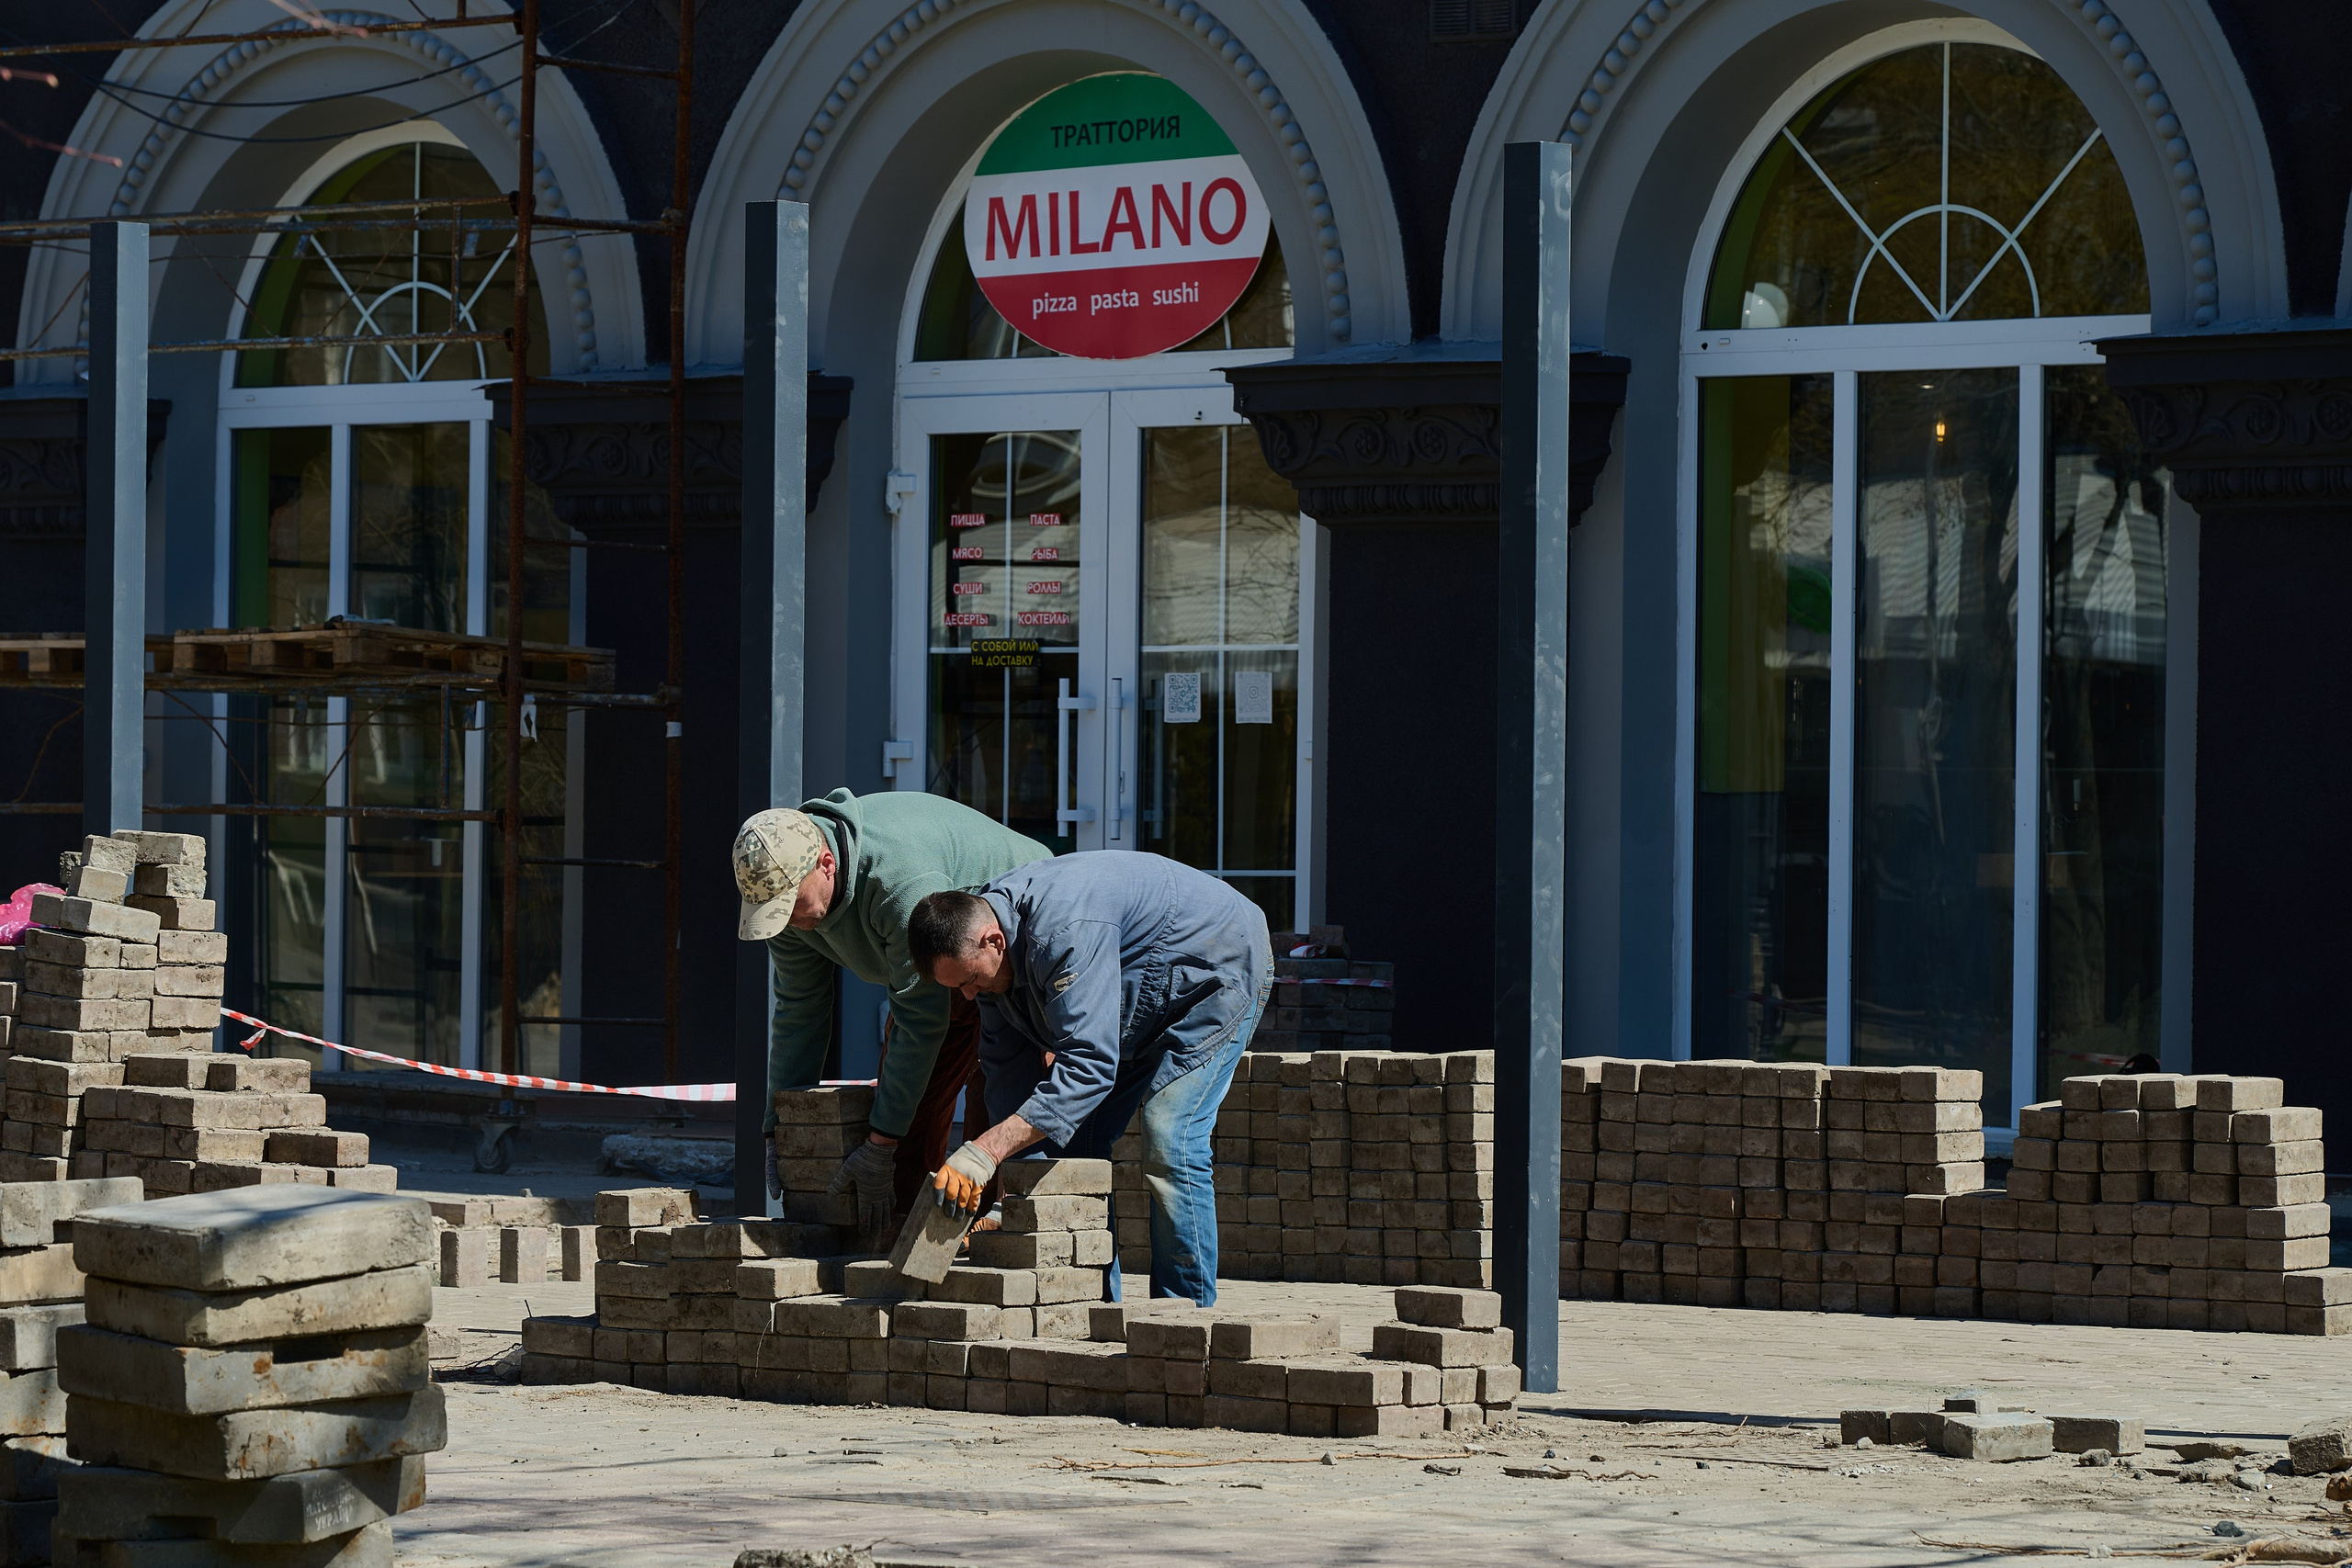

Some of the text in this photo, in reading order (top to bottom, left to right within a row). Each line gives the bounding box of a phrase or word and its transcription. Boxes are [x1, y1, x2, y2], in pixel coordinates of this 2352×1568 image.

[1050, 116, 1181, 149] ТРАТТОРИЯ
[985, 176, 1248, 262] MILANO
[1032, 281, 1200, 320] pizza pasta sushi
[950, 513, 986, 526] ПИЦЦА
[1030, 513, 1060, 525] ПАСТА
[953, 547, 983, 559] МЯСО
[1031, 548, 1058, 560] РЫБА
[953, 582, 983, 594] СУШИ
[1027, 581, 1061, 593] РОЛЛЫ
[944, 614, 989, 626] ДЕСЕРТЫ
[971, 639, 1038, 651] С СОБОЙ ИЛИ
[971, 655, 1034, 667] НА ДОСТАВКУ
